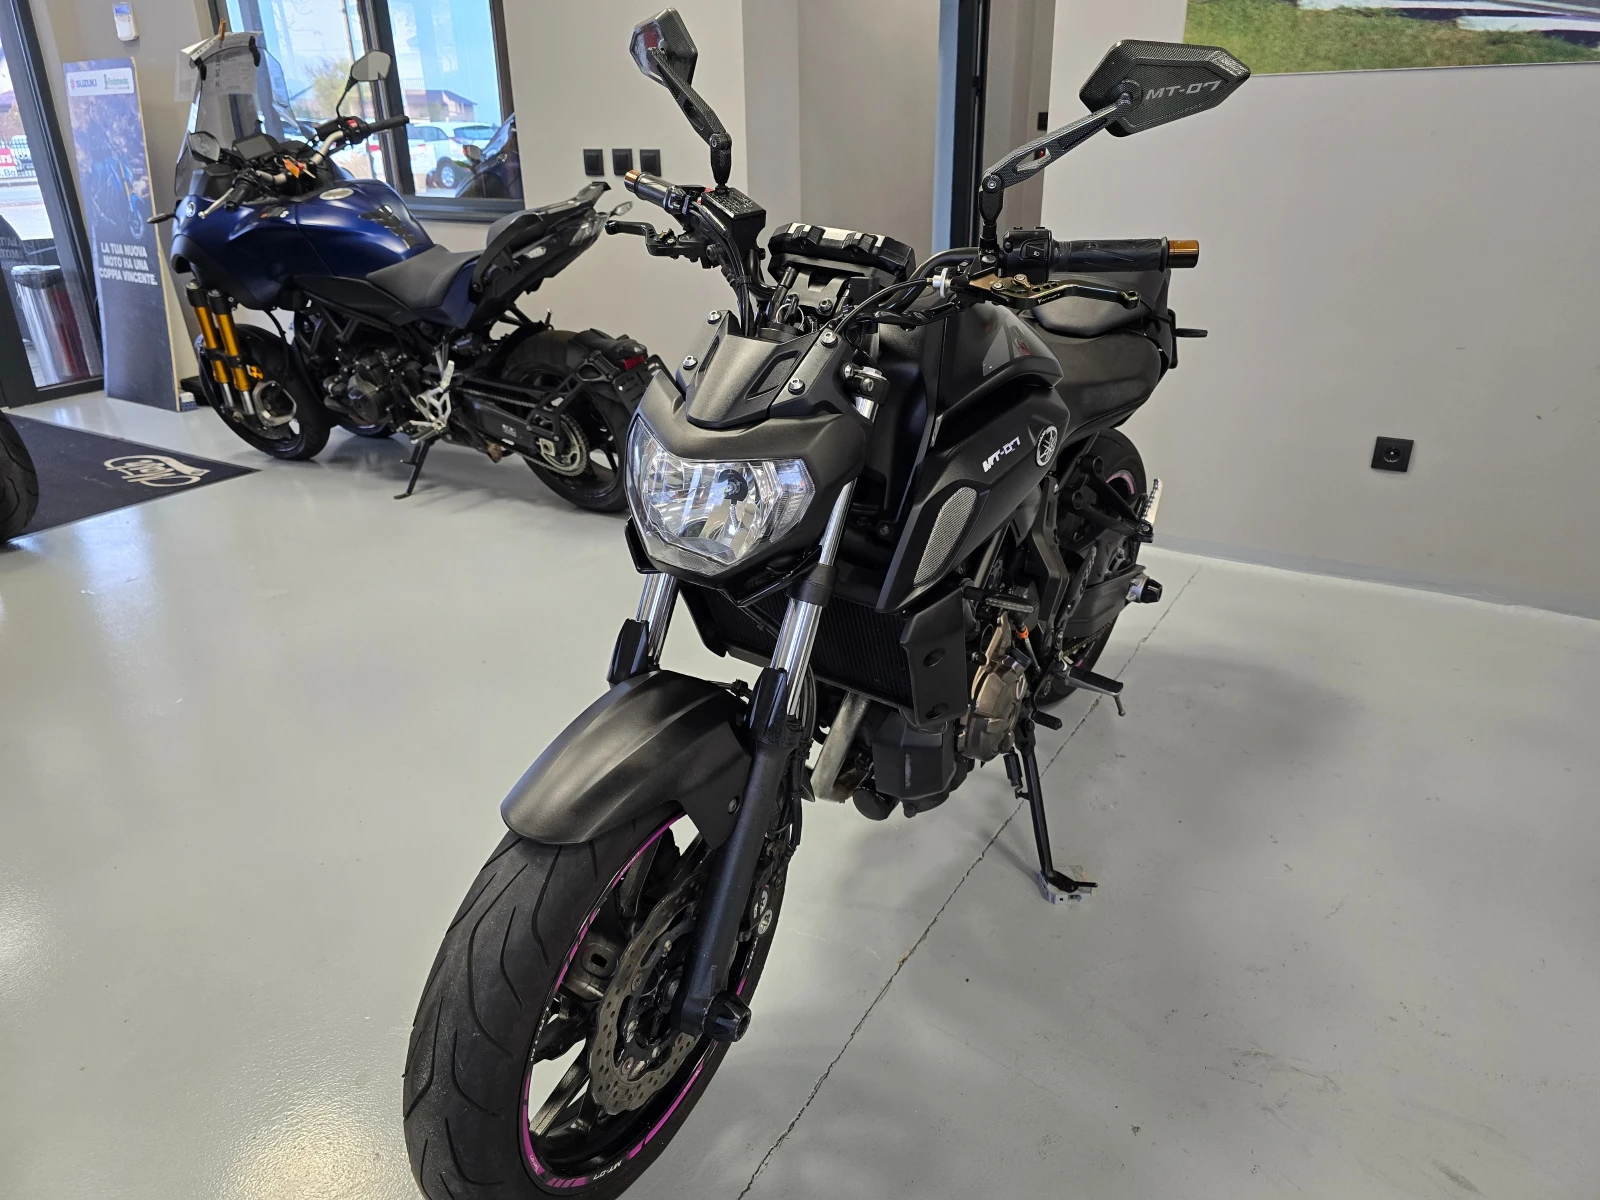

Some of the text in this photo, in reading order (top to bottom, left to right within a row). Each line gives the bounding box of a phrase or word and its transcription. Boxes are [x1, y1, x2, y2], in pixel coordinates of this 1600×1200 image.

[76, 79, 97, 88] SUZUKI
[1145, 80, 1222, 100] MT-07
[100, 242, 148, 258] LA TUA NUOVA
[103, 255, 149, 271] MOTO HA UNA
[99, 267, 123, 280] COPPIA
[982, 436, 1020, 473] MT-07
[593, 1160, 623, 1180] MT-07
